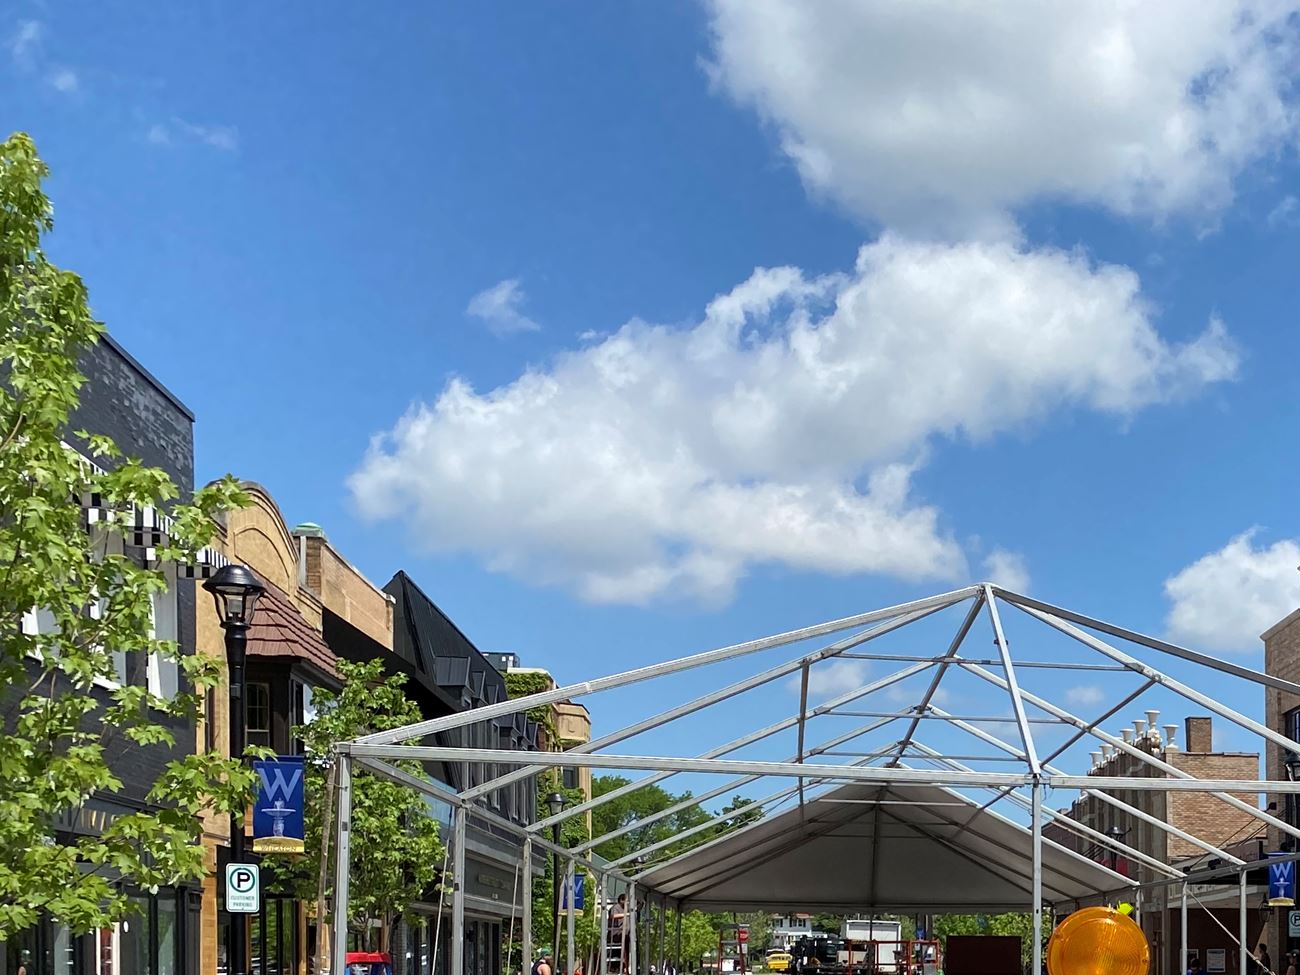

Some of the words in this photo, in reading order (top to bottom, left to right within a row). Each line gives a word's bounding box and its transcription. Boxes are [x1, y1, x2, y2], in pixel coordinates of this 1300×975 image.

[258, 768, 302, 802] W
[1272, 861, 1292, 879] W
[237, 872, 250, 888] P
